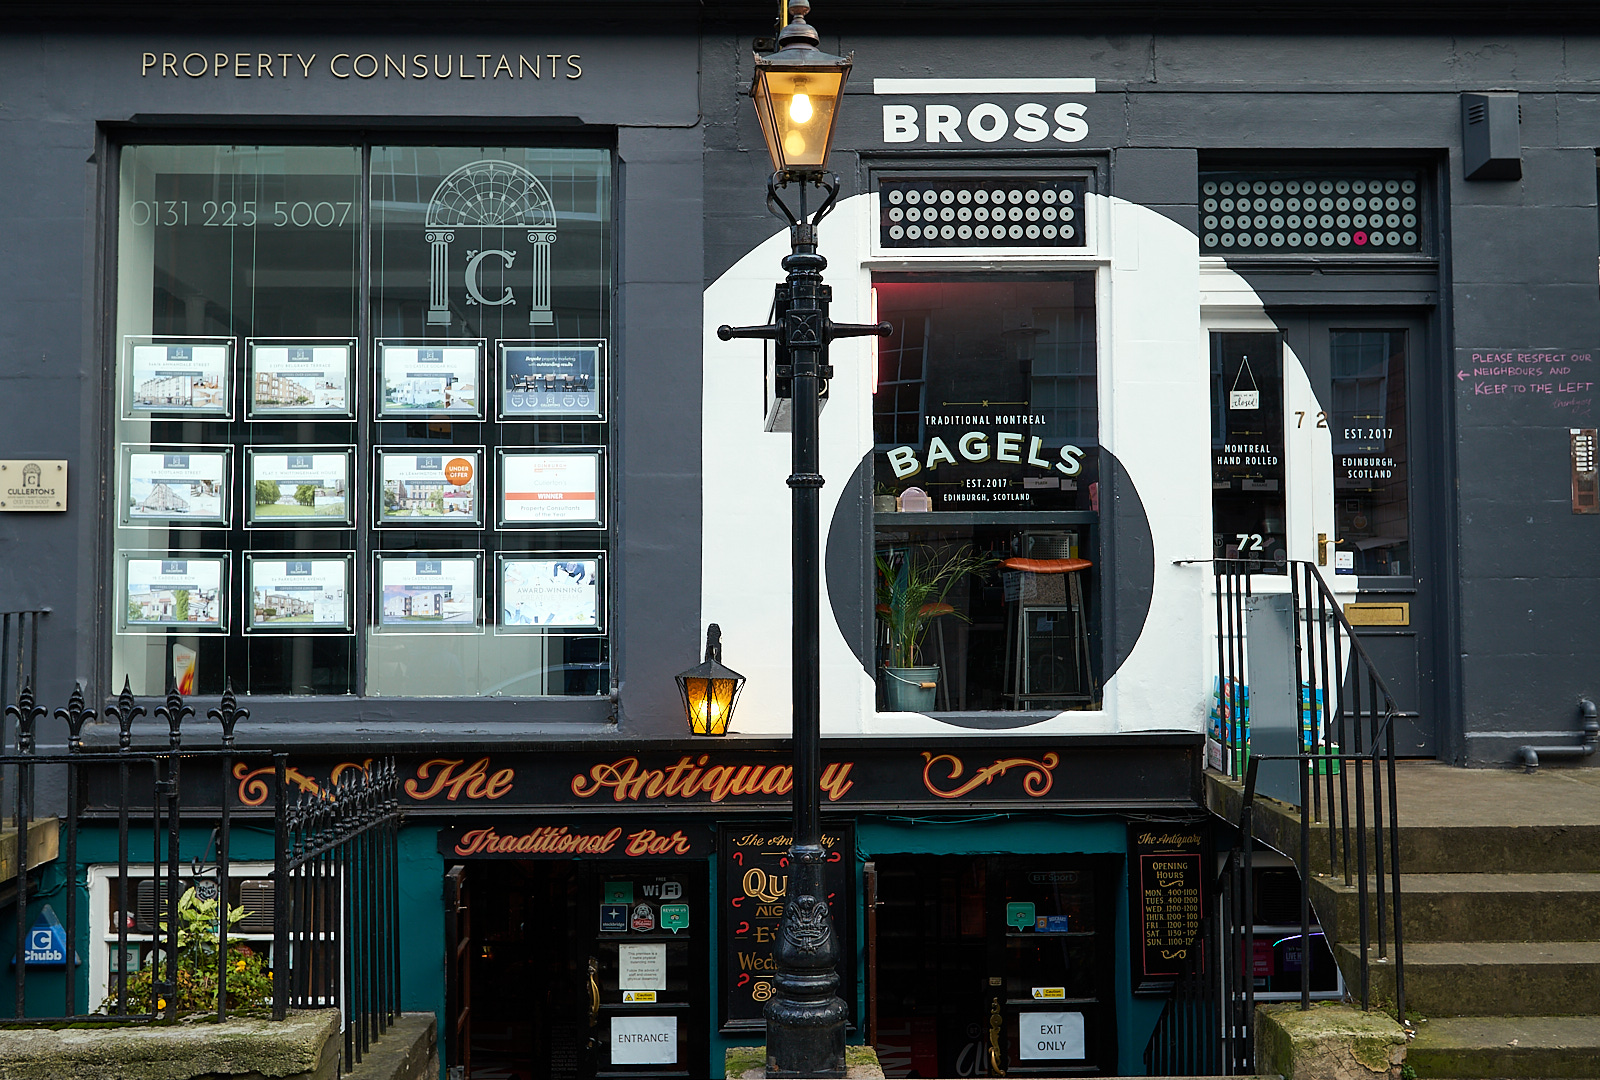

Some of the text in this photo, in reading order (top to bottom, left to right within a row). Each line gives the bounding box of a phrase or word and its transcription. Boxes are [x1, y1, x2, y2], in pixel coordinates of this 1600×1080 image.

[140, 52, 584, 80] PROPERTY CONSULTANTS
[882, 102, 1089, 143] BROSS
[129, 200, 353, 228] 0131 225 5007
[1472, 353, 1592, 364] PLEASE RESPECT OUR
[1473, 366, 1571, 377] NEIGHBOURS AND
[1474, 381, 1594, 395] KEEP TO THE LEFT
[925, 415, 1046, 425] TRADITIONAL MONTREAL
[1294, 411, 1328, 429] 7 2
[1344, 428, 1393, 440] EST.2017
[1224, 444, 1271, 453] MONTREAL
[886, 431, 1086, 480] BAGELS
[1217, 456, 1278, 465] HAND ROLLED
[1342, 457, 1397, 468] EDINBURGH,
[1347, 469, 1392, 479] SCOTLAND
[966, 479, 1007, 488] EST.2017
[7, 488, 56, 496] CULLERTON'S
[943, 493, 1030, 502] EDINBURGH, SCOTLAND
[1236, 533, 1263, 551] 72
[404, 754, 855, 803] The Antiquay
[454, 826, 691, 857] Traditional Bar
[1137, 832, 1201, 848] The Antiquary
[1152, 861, 1188, 870] OPENING
[1048, 873, 1073, 882] Sport
[1156, 871, 1184, 879] HOURS
[1040, 1024, 1063, 1035] EXIT
[618, 1033, 669, 1044] ENTRANCE
[1037, 1041, 1066, 1051] ONLY
